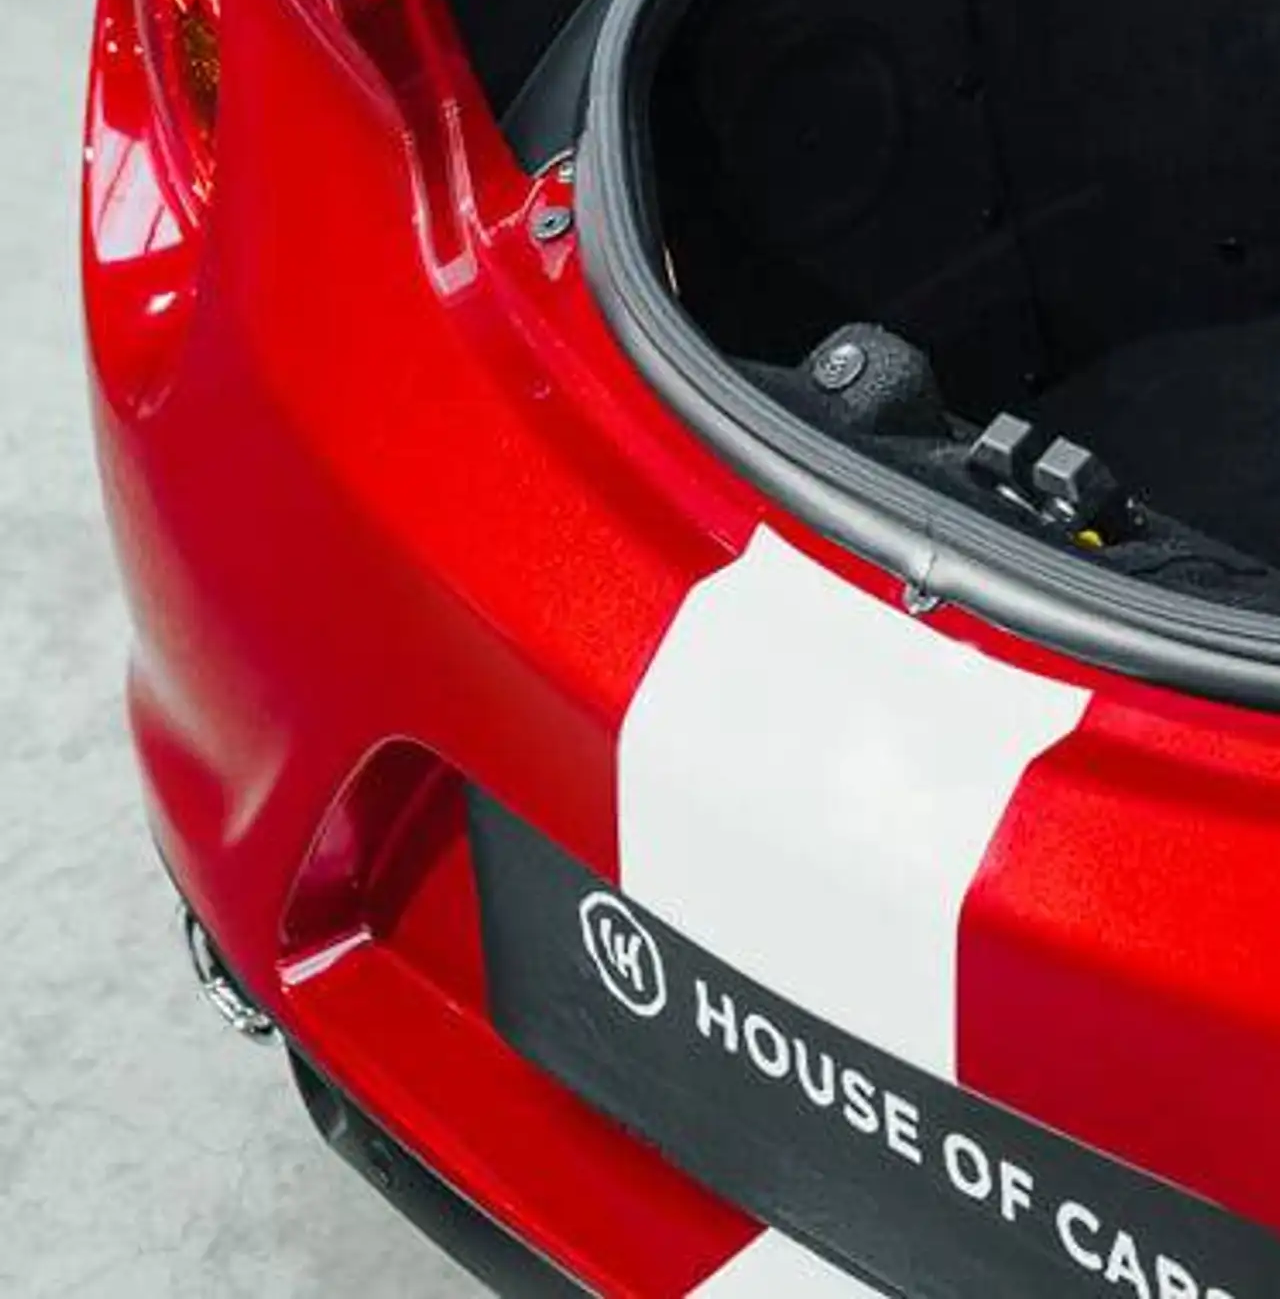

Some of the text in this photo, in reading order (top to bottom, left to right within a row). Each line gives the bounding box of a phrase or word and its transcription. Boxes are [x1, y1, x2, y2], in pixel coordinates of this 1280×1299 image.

[694, 978, 1236, 1299] HOUSE OF CAR
